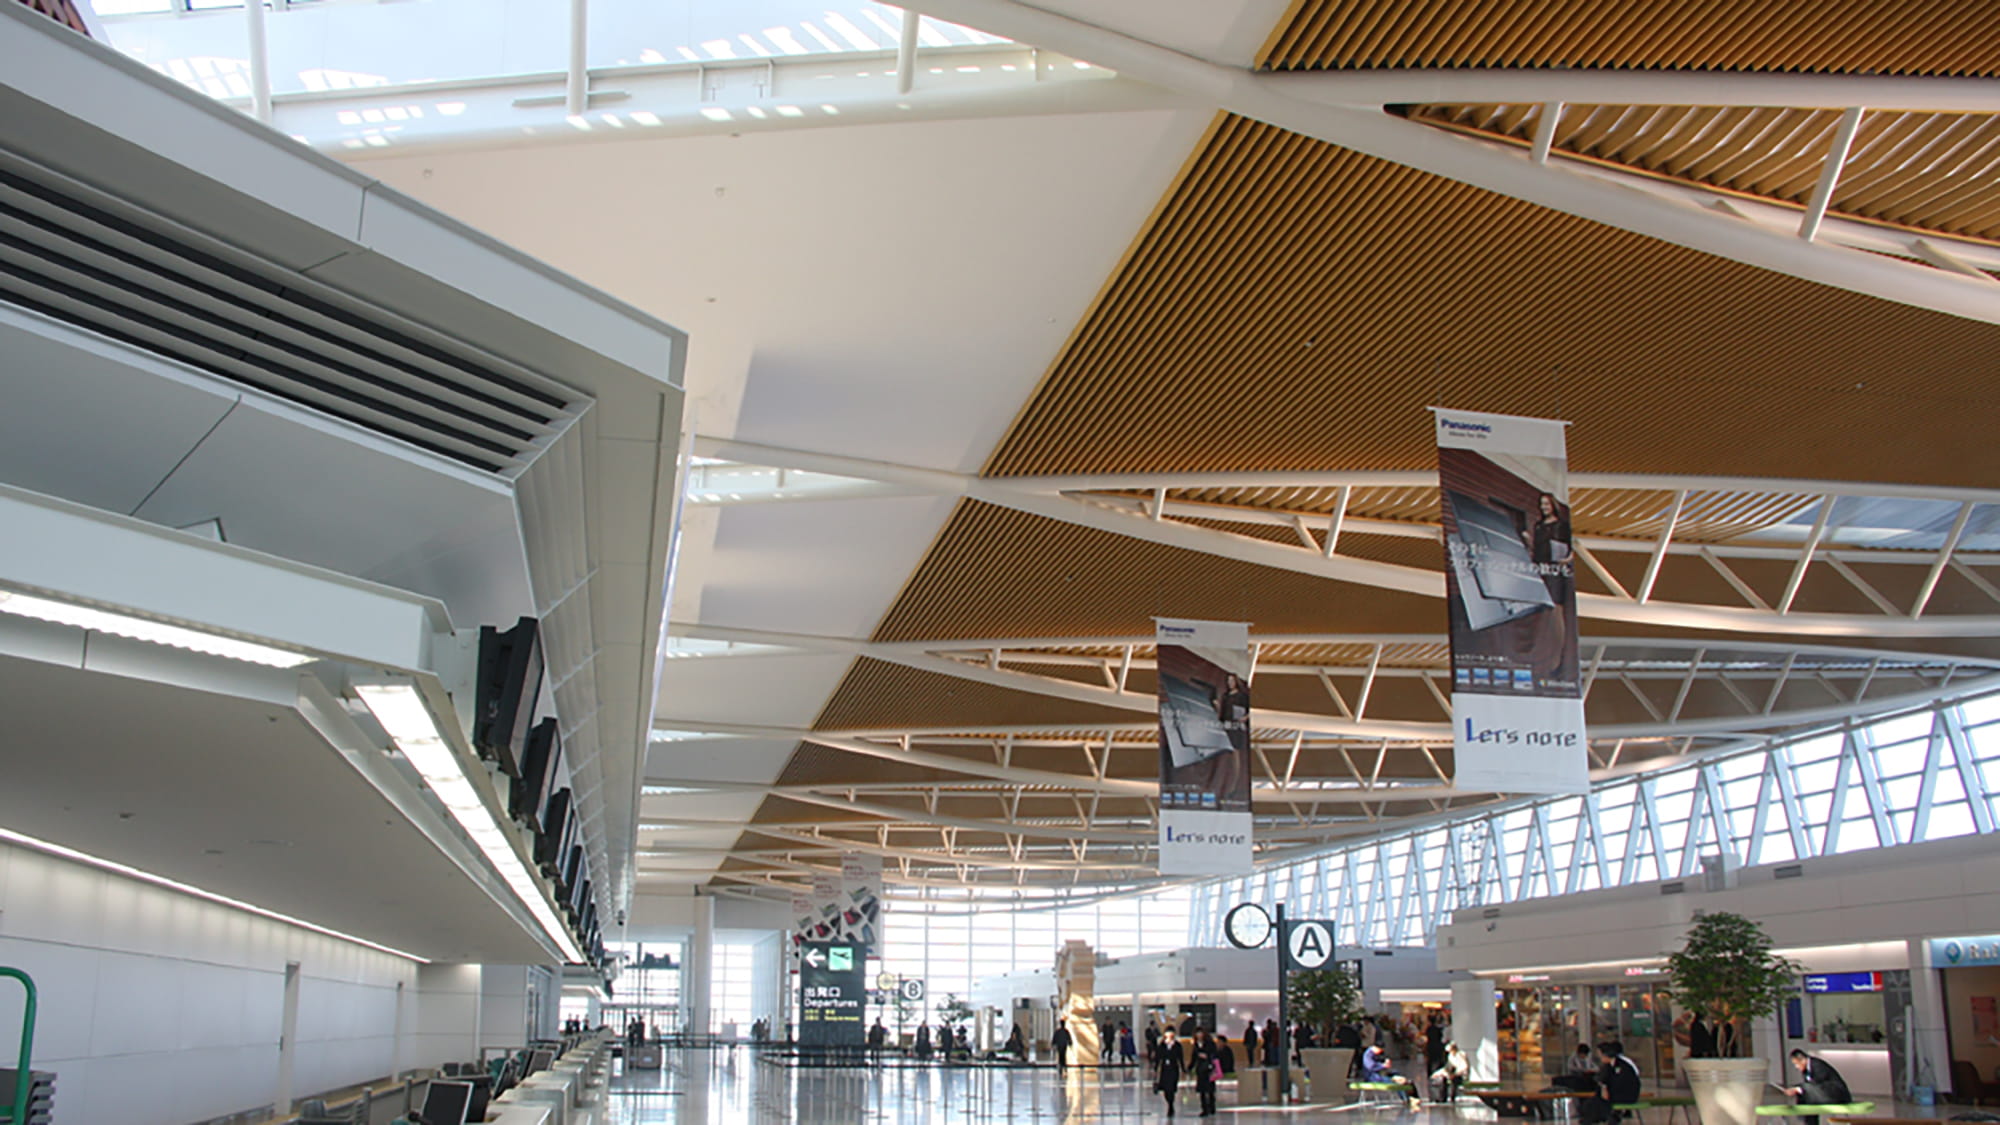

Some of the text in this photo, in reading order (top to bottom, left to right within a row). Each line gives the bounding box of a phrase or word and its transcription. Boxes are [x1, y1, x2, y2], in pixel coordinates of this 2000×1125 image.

[1441, 418, 1492, 434] Panasonic
[1465, 717, 1577, 747] Let's note
[1297, 926, 1325, 958] A
[908, 982, 919, 998] B
[804, 998, 858, 1008] Departures
